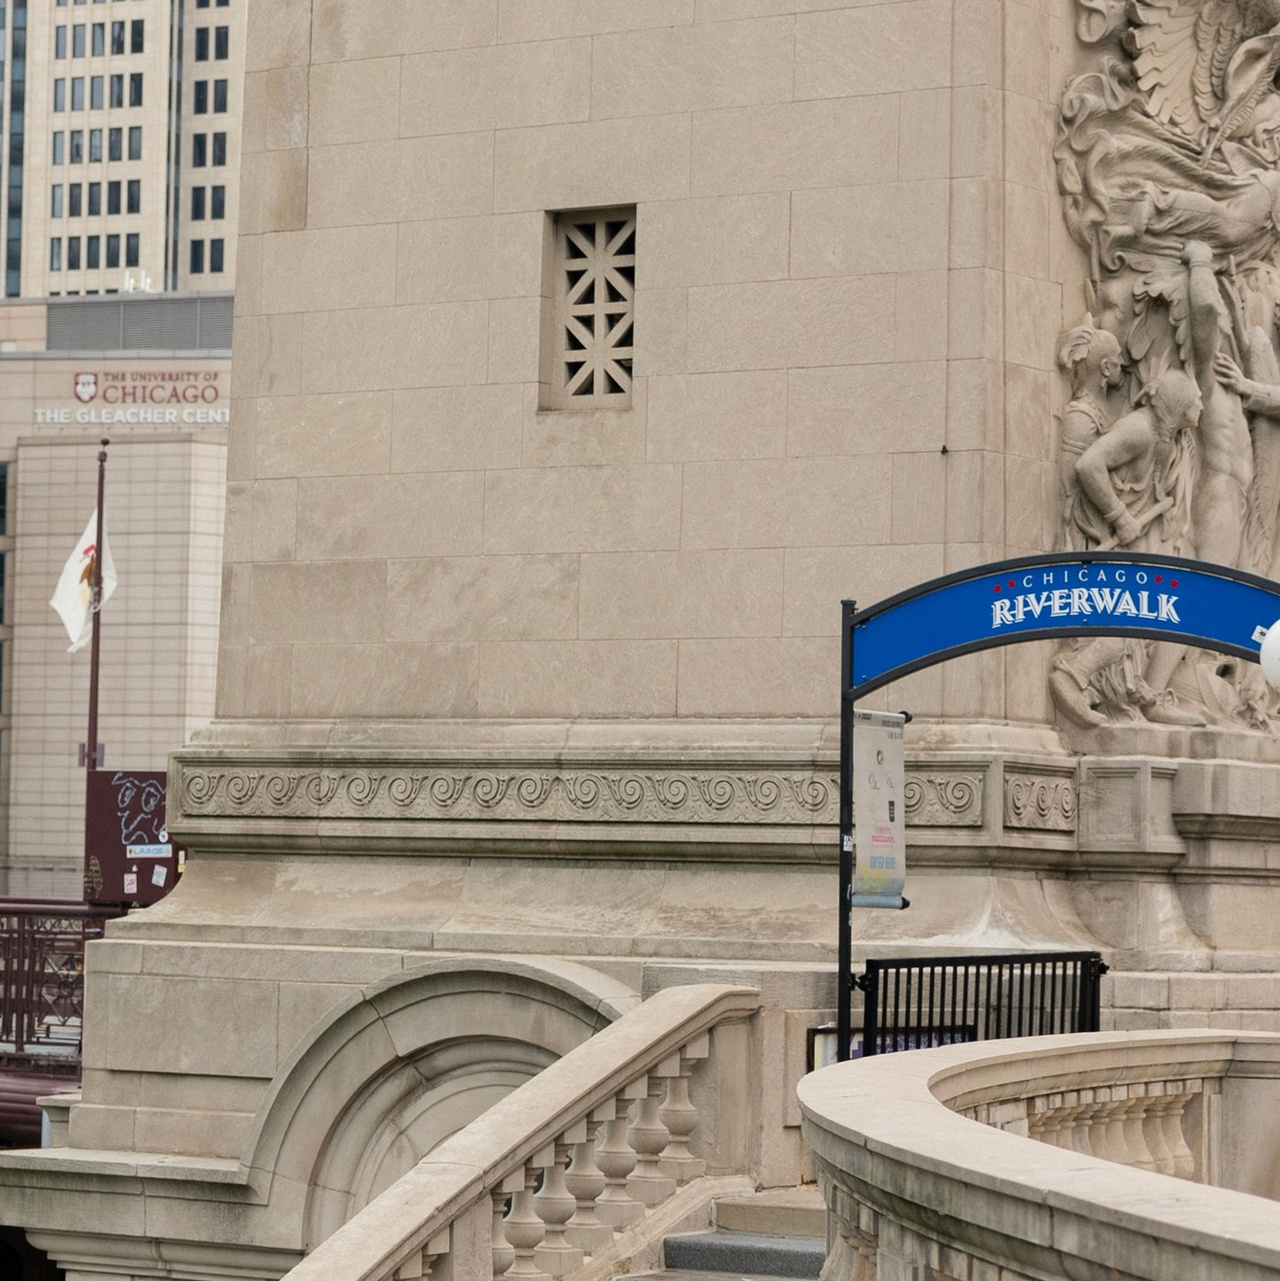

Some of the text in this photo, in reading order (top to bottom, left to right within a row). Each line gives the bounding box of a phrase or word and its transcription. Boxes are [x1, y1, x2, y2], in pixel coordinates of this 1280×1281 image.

[104, 372, 218, 382] THE UNIVERSITY OF
[102, 384, 219, 404] CHICAGO
[34, 408, 70, 424] THE
[75, 407, 177, 424] GLEACHER
[1022, 569, 1148, 588] CHICAGO
[991, 587, 1181, 628] RIVERWALK
